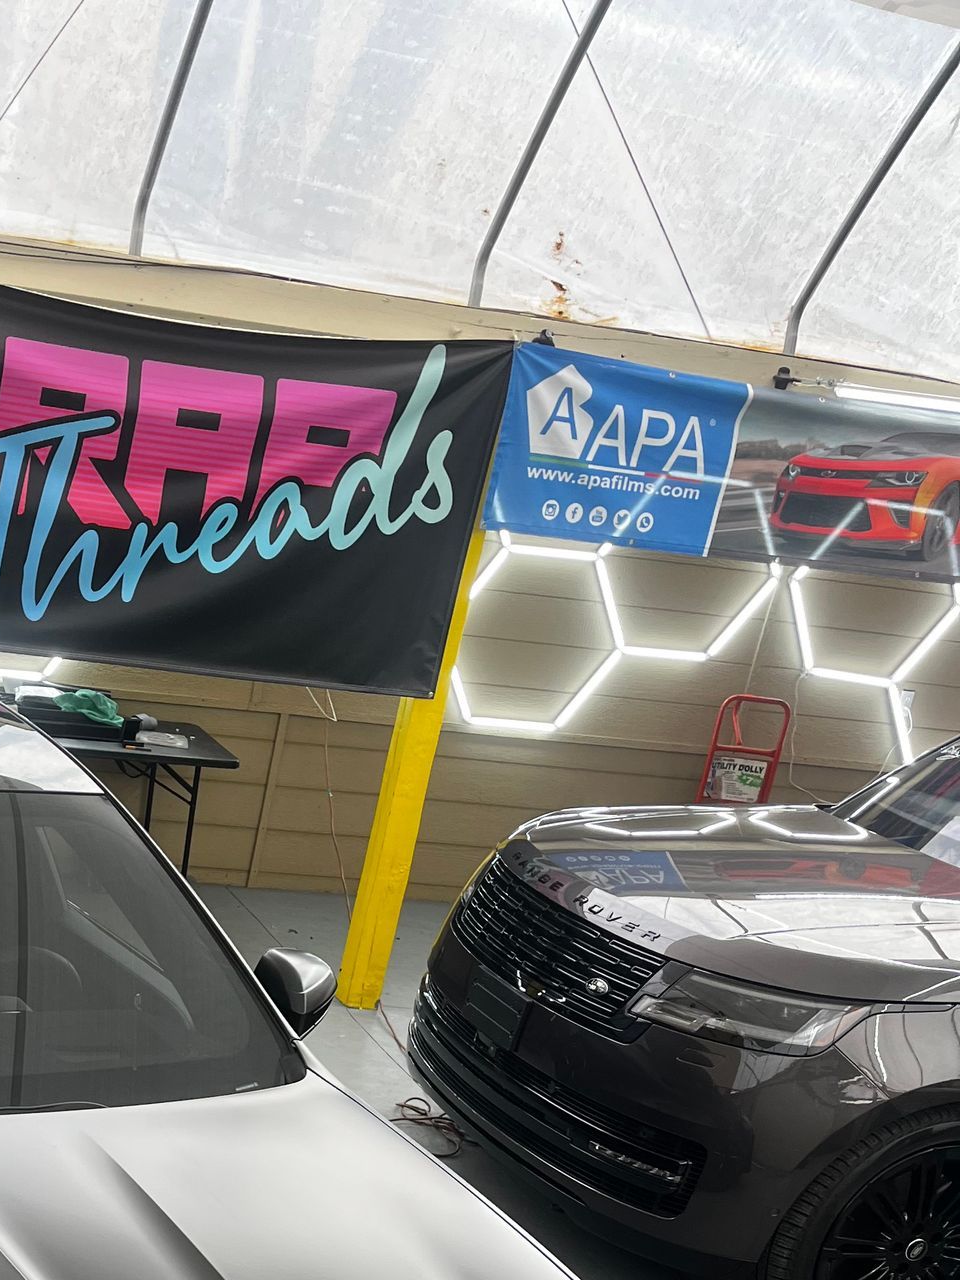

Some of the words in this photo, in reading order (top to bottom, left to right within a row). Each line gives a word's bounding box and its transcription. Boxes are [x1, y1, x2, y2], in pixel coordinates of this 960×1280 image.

[527, 466, 700, 500] www.apafilms.com
[738, 763, 764, 774] DOLLY
[512, 852, 564, 892] RANGE
[573, 895, 661, 942] ROVER
